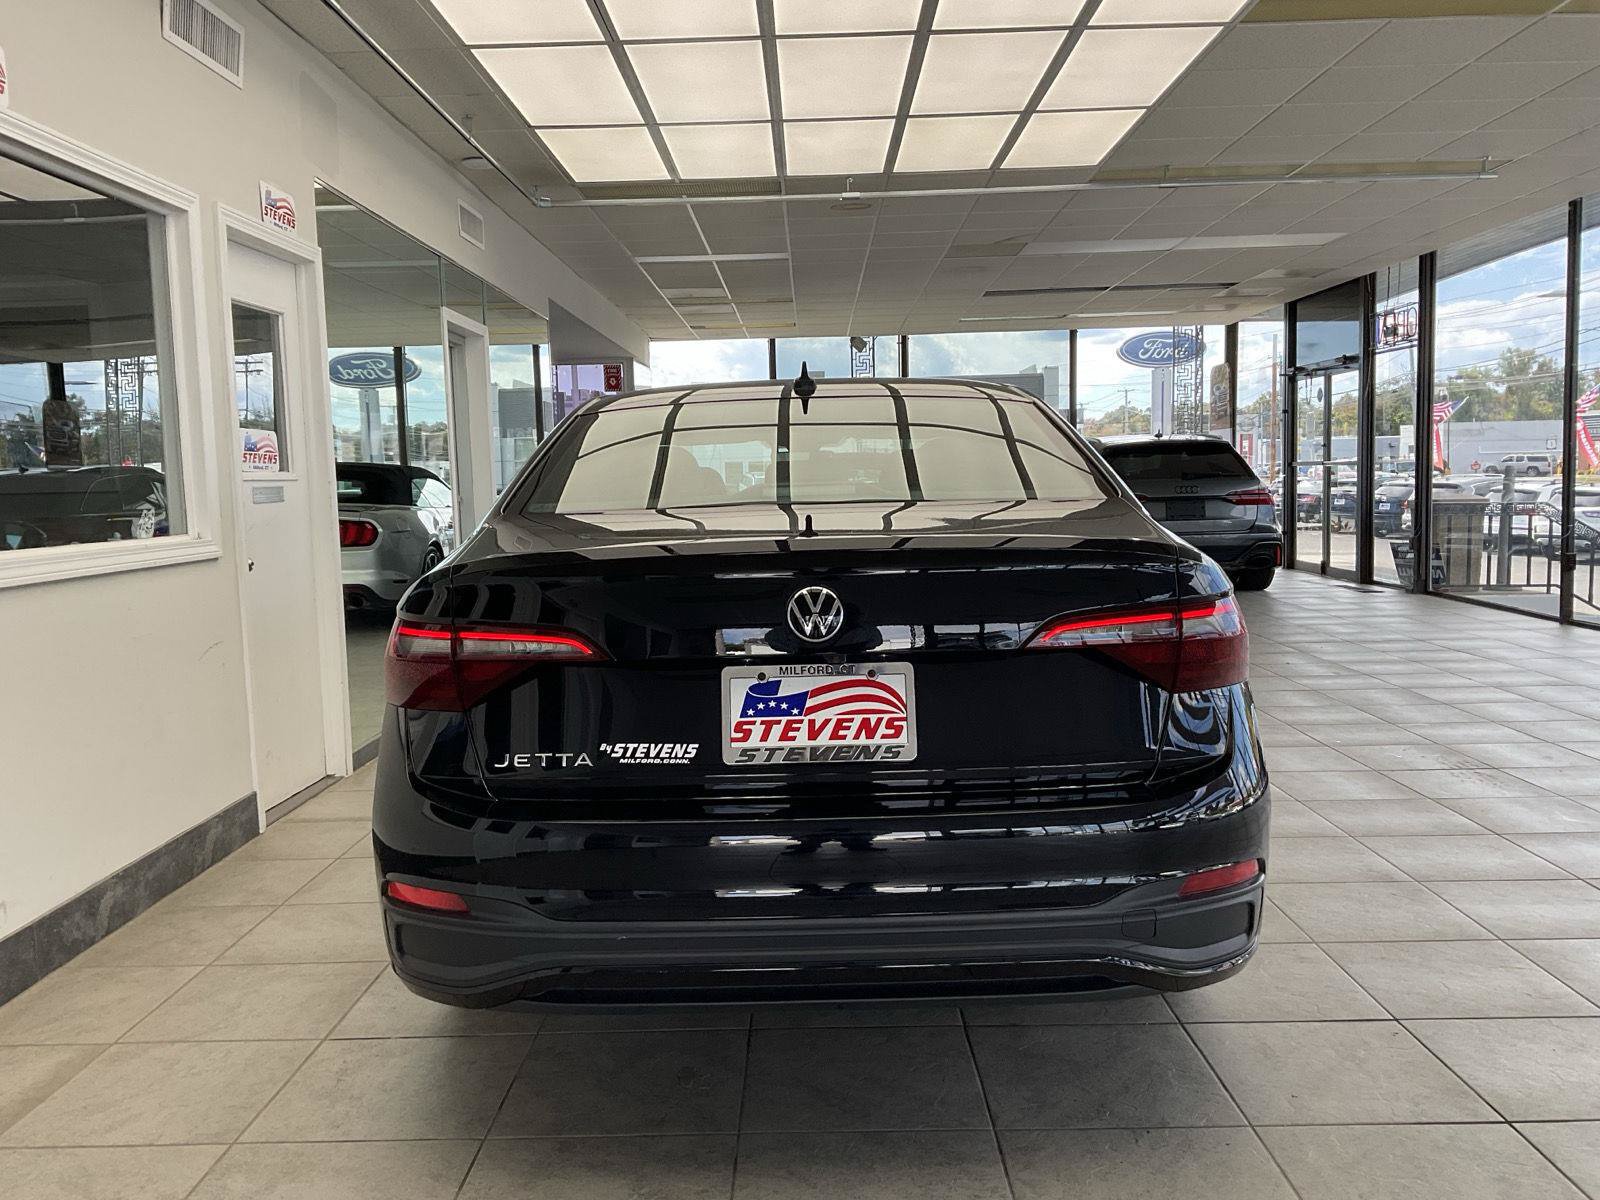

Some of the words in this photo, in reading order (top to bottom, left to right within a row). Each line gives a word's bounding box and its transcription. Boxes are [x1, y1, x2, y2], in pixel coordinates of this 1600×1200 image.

[264, 206, 296, 230] STEVENS
[1139, 338, 1189, 359] Ford
[242, 452, 278, 465] STEVENS
[840, 664, 856, 674] CT
[730, 717, 907, 743] STEVENS
[611, 743, 700, 758] STEVENS
[735, 745, 905, 763] STEVENS
[494, 752, 594, 768] JETTA
